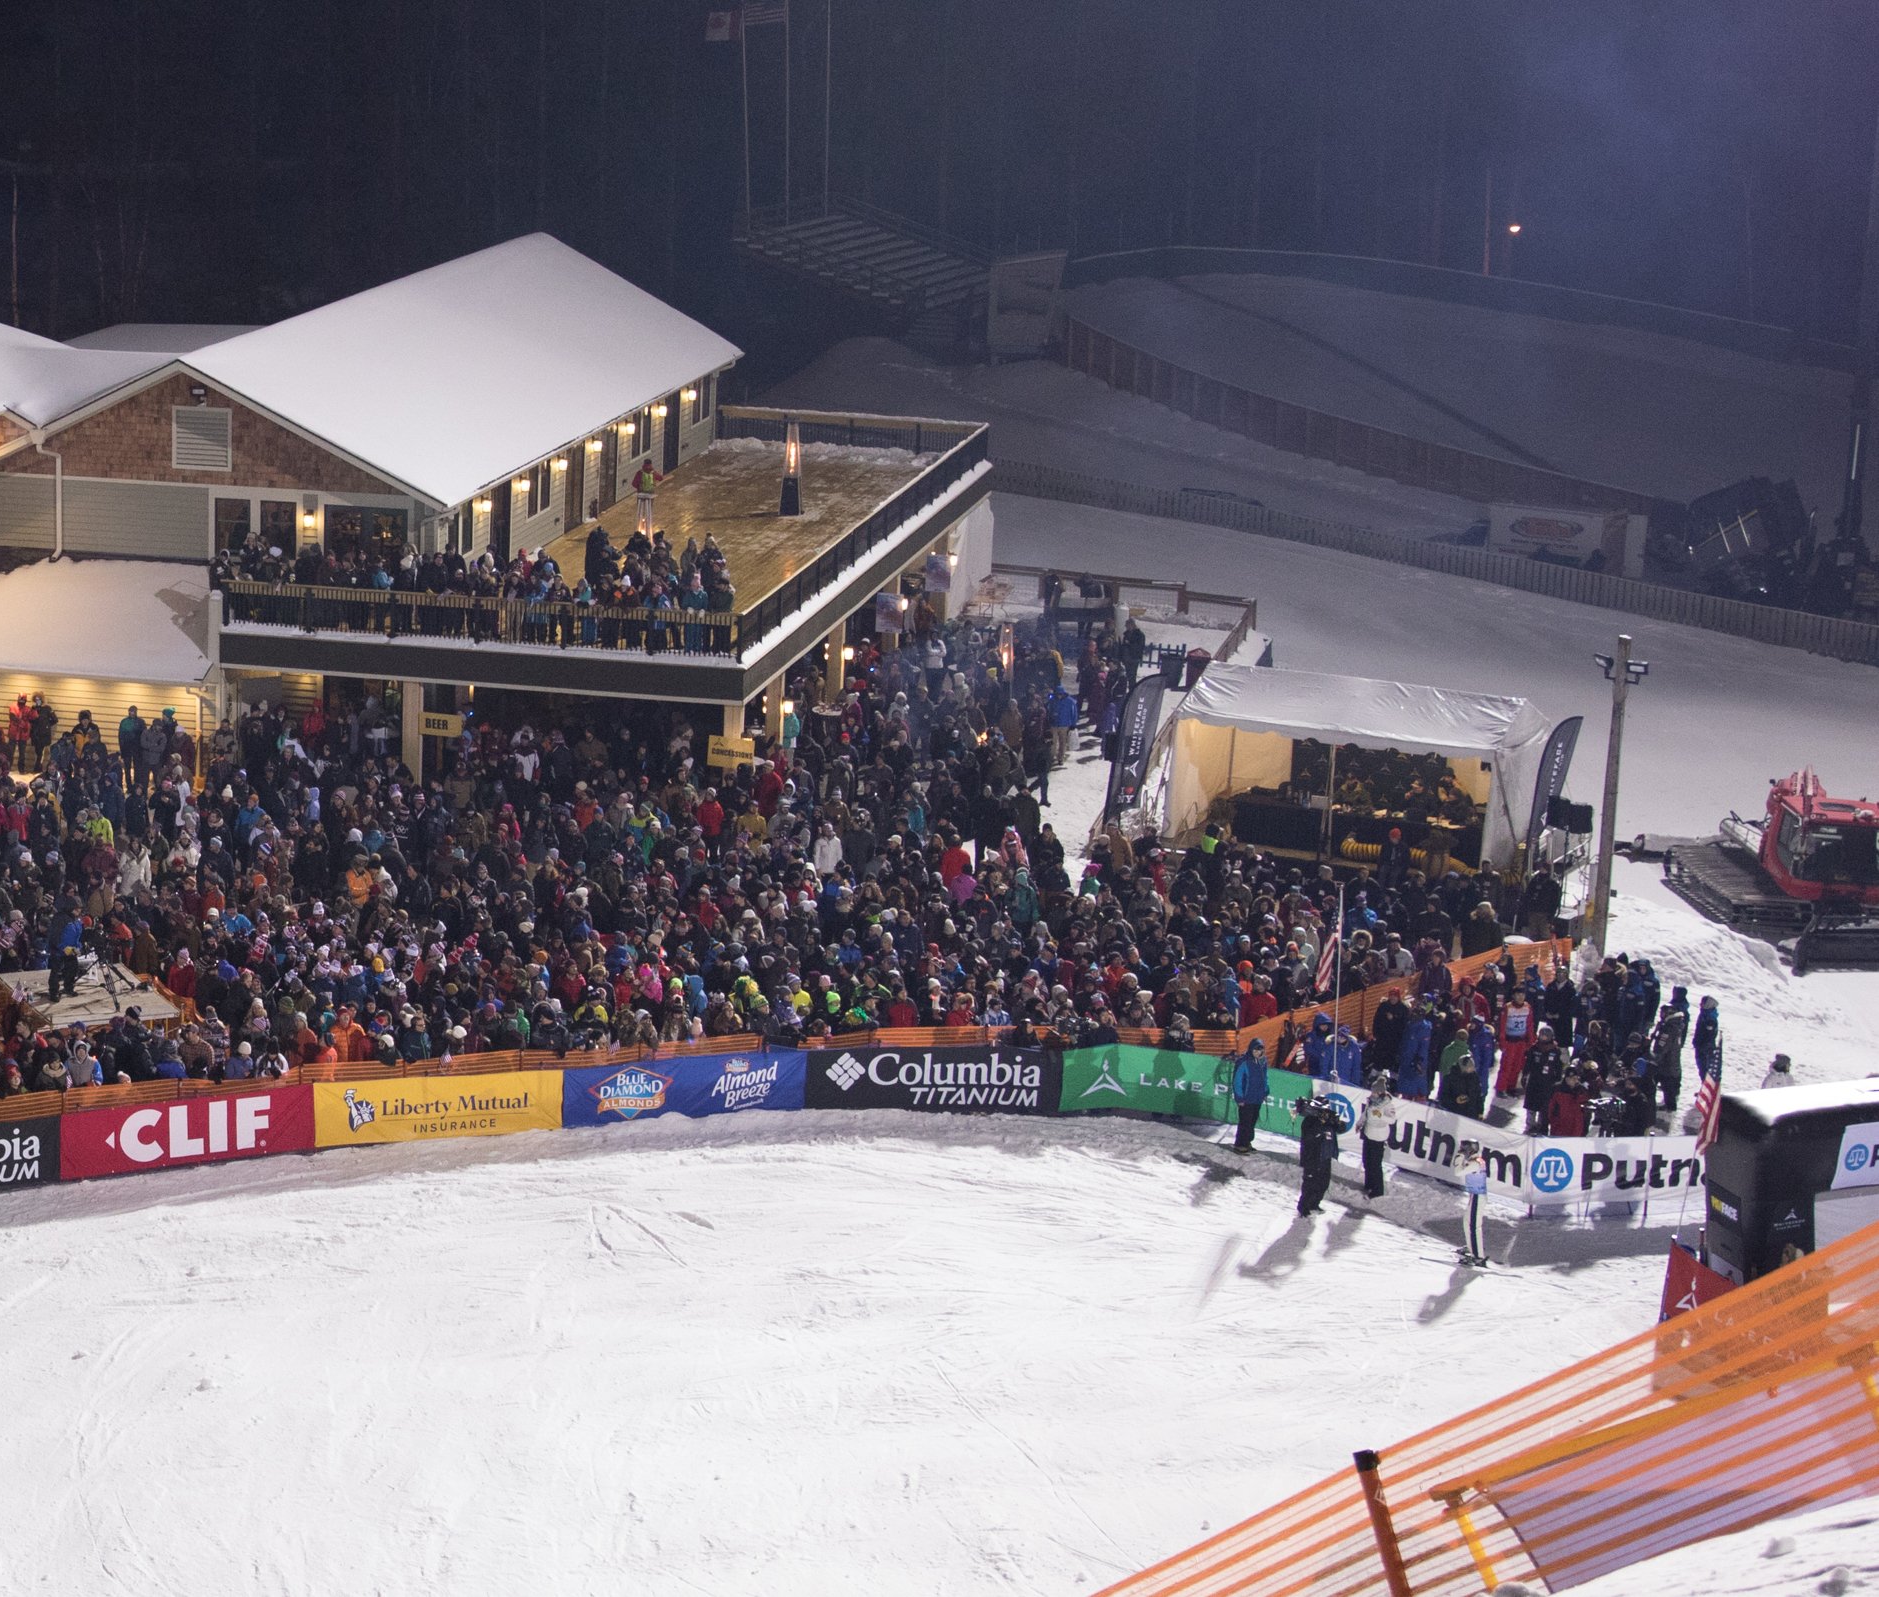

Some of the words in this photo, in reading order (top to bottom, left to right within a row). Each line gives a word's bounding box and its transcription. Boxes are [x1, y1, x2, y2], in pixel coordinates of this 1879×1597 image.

[425, 717, 449, 731] BEER
[1128, 697, 1146, 756] WHITEFACE
[711, 747, 753, 760] CONCESSIONS
[1117, 794, 1135, 804] NY
[616, 1073, 648, 1087] BLUE
[711, 1060, 778, 1097] Almond
[867, 1051, 1041, 1088] Columbia
[599, 1079, 664, 1099] DIAMOND
[1139, 1073, 1203, 1093] LAKE
[381, 1098, 452, 1120] Liberty
[457, 1092, 529, 1112] Mutual
[603, 1097, 661, 1109] ALMONDS
[724, 1082, 771, 1108] Breeze
[909, 1085, 1038, 1107] TITANIUM
[118, 1095, 271, 1163] CLIF
[413, 1118, 497, 1133] INSURANCE
[1362, 1103, 1522, 1188] utnm
[1580, 1152, 1706, 1191] Putn
